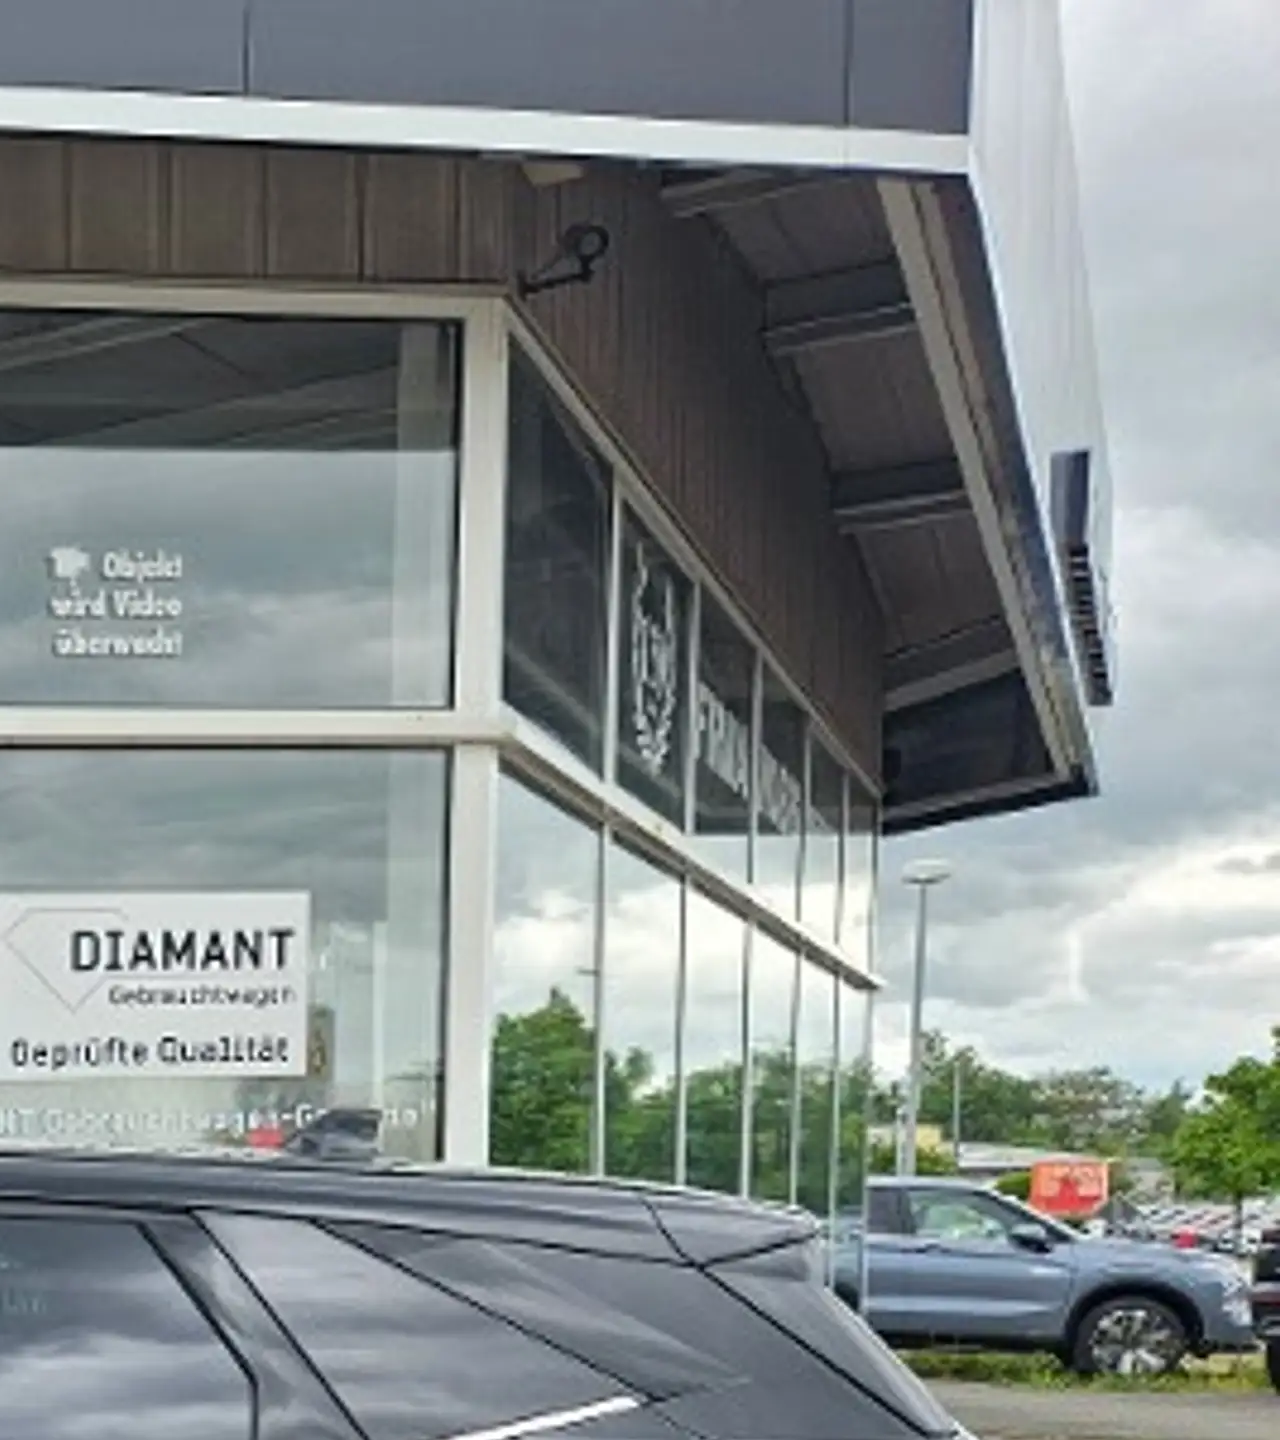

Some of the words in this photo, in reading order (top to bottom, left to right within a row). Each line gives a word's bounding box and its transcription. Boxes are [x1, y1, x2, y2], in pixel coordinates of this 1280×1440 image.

[51, 588, 106, 616] wird
[113, 587, 182, 616] Video
[71, 930, 295, 971] DIAMANT
[108, 984, 298, 1009] Gebrauchtwagen
[11, 1034, 149, 1070] Geprüfte
[157, 1034, 290, 1064] Qualität
